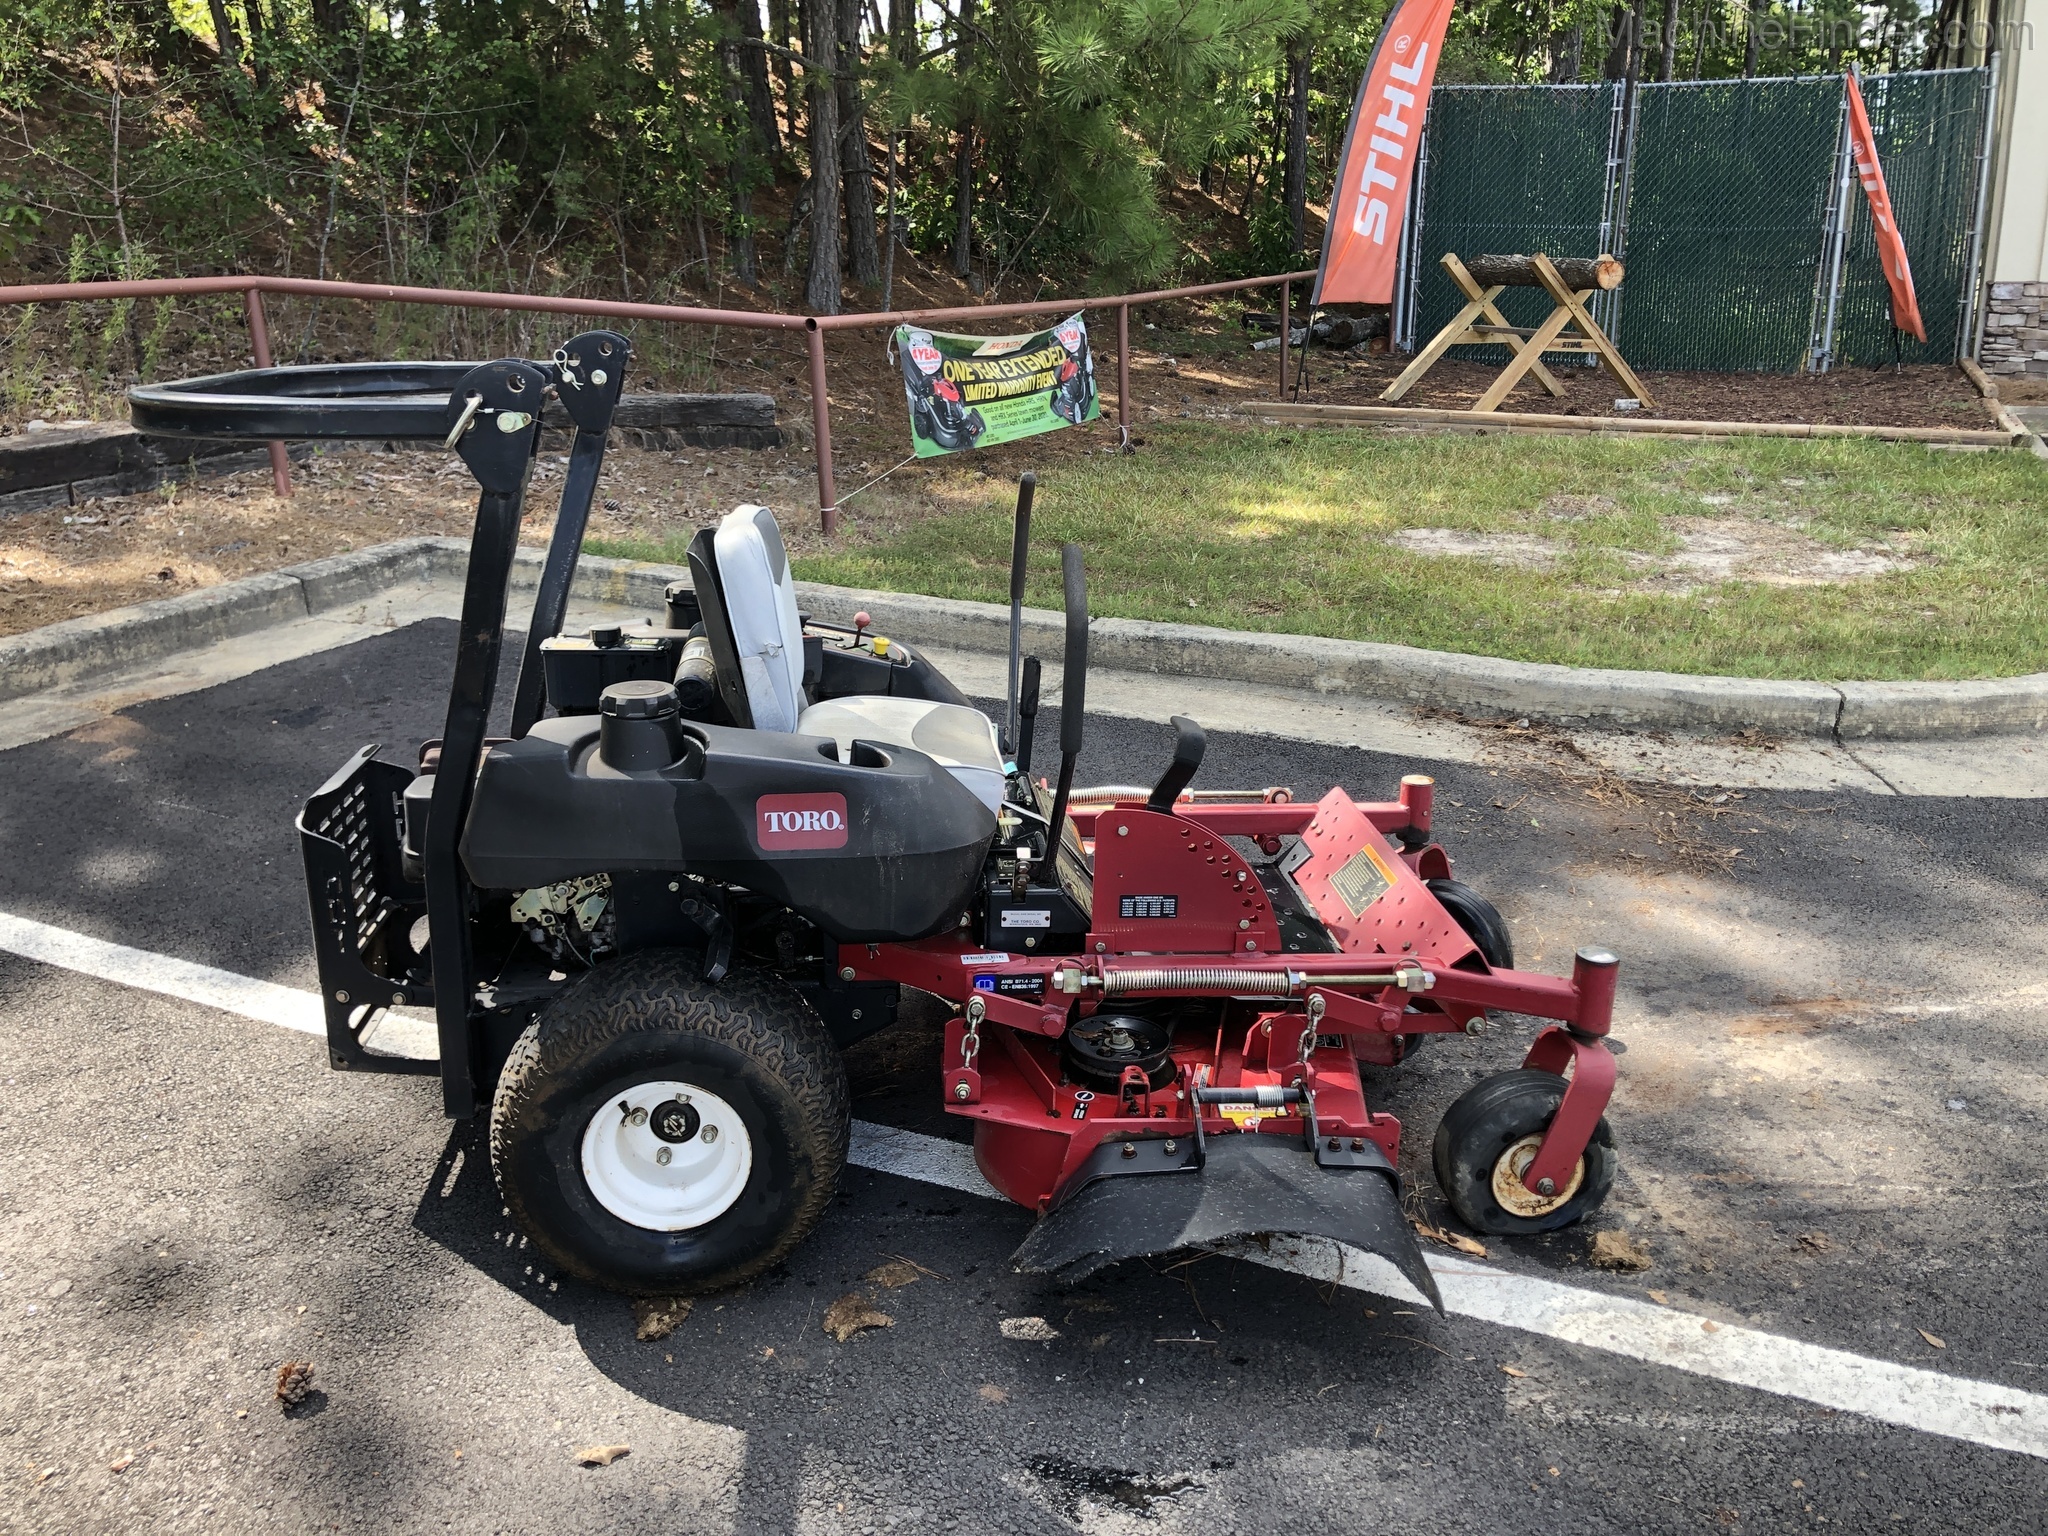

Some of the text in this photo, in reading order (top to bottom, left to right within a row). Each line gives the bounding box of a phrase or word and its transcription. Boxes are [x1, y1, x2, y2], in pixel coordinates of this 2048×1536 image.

[1352, 41, 1429, 246] STIHL
[917, 348, 941, 361] YEAR
[988, 340, 1024, 350] HONDA
[1561, 341, 1583, 349] STIHL
[943, 345, 1067, 383] ONE YEAR EXTENDED
[963, 370, 1058, 402] LIMITED WARRANTY EVENT
[764, 809, 841, 833] TORO
